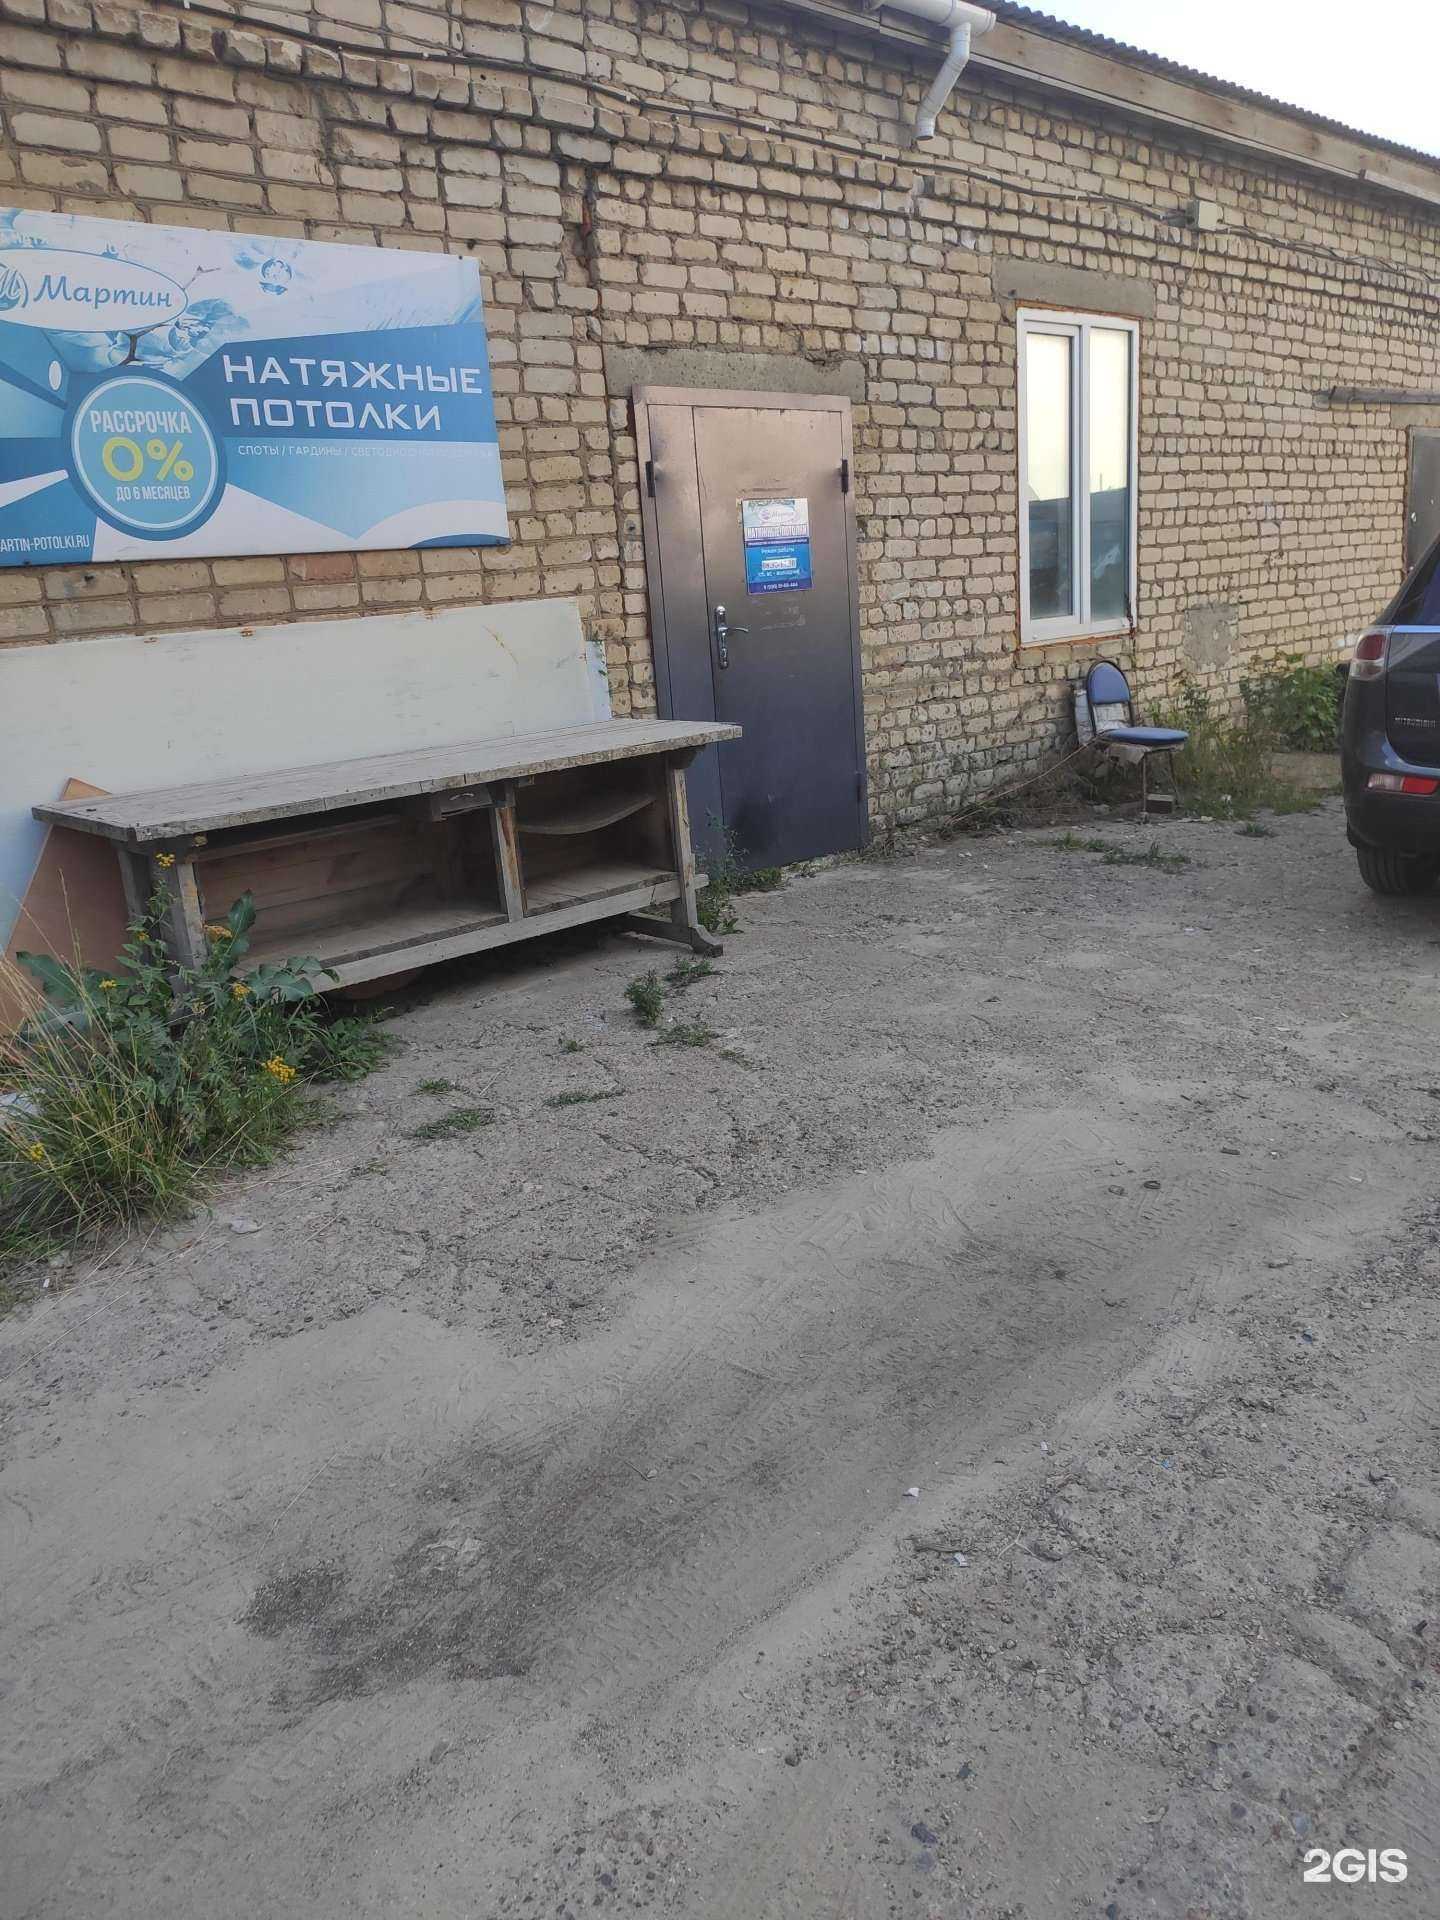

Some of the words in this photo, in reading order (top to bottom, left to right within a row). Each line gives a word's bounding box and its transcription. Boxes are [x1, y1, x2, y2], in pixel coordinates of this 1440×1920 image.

[33, 274, 172, 309] Мартин
[222, 354, 483, 394] НАТЯЖНЫЕ
[89, 410, 192, 434] РАССРОЧКА
[229, 397, 441, 431] ПОТОЛКИ
[102, 436, 194, 482] 0%
[238, 445, 279, 456] СПОТЫ
[289, 446, 341, 456] ГАРДИНЫ
[116, 486, 132, 501] ДО
[133, 486, 140, 500] 6
[142, 485, 191, 501] МЕСЯЦЕВ
[0, 534, 90, 552] ARTIN-POTOLKI.RU
